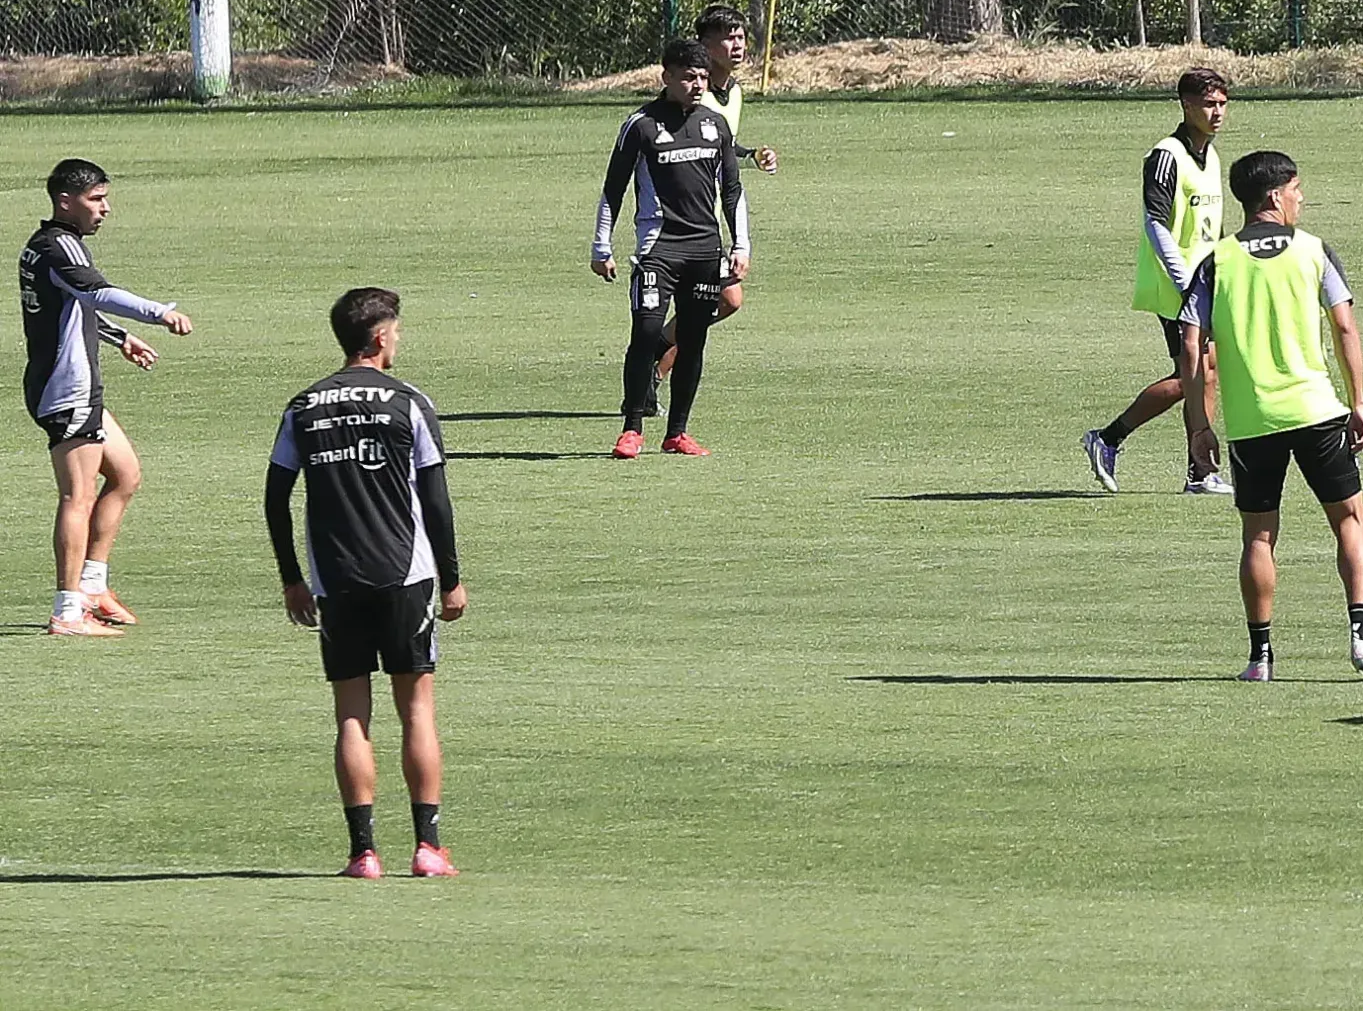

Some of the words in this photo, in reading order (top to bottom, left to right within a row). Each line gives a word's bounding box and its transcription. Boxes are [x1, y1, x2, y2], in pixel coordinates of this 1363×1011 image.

[643, 271, 657, 286] 10
[305, 386, 396, 410] DIRECTV
[304, 413, 392, 432] JETOUR
